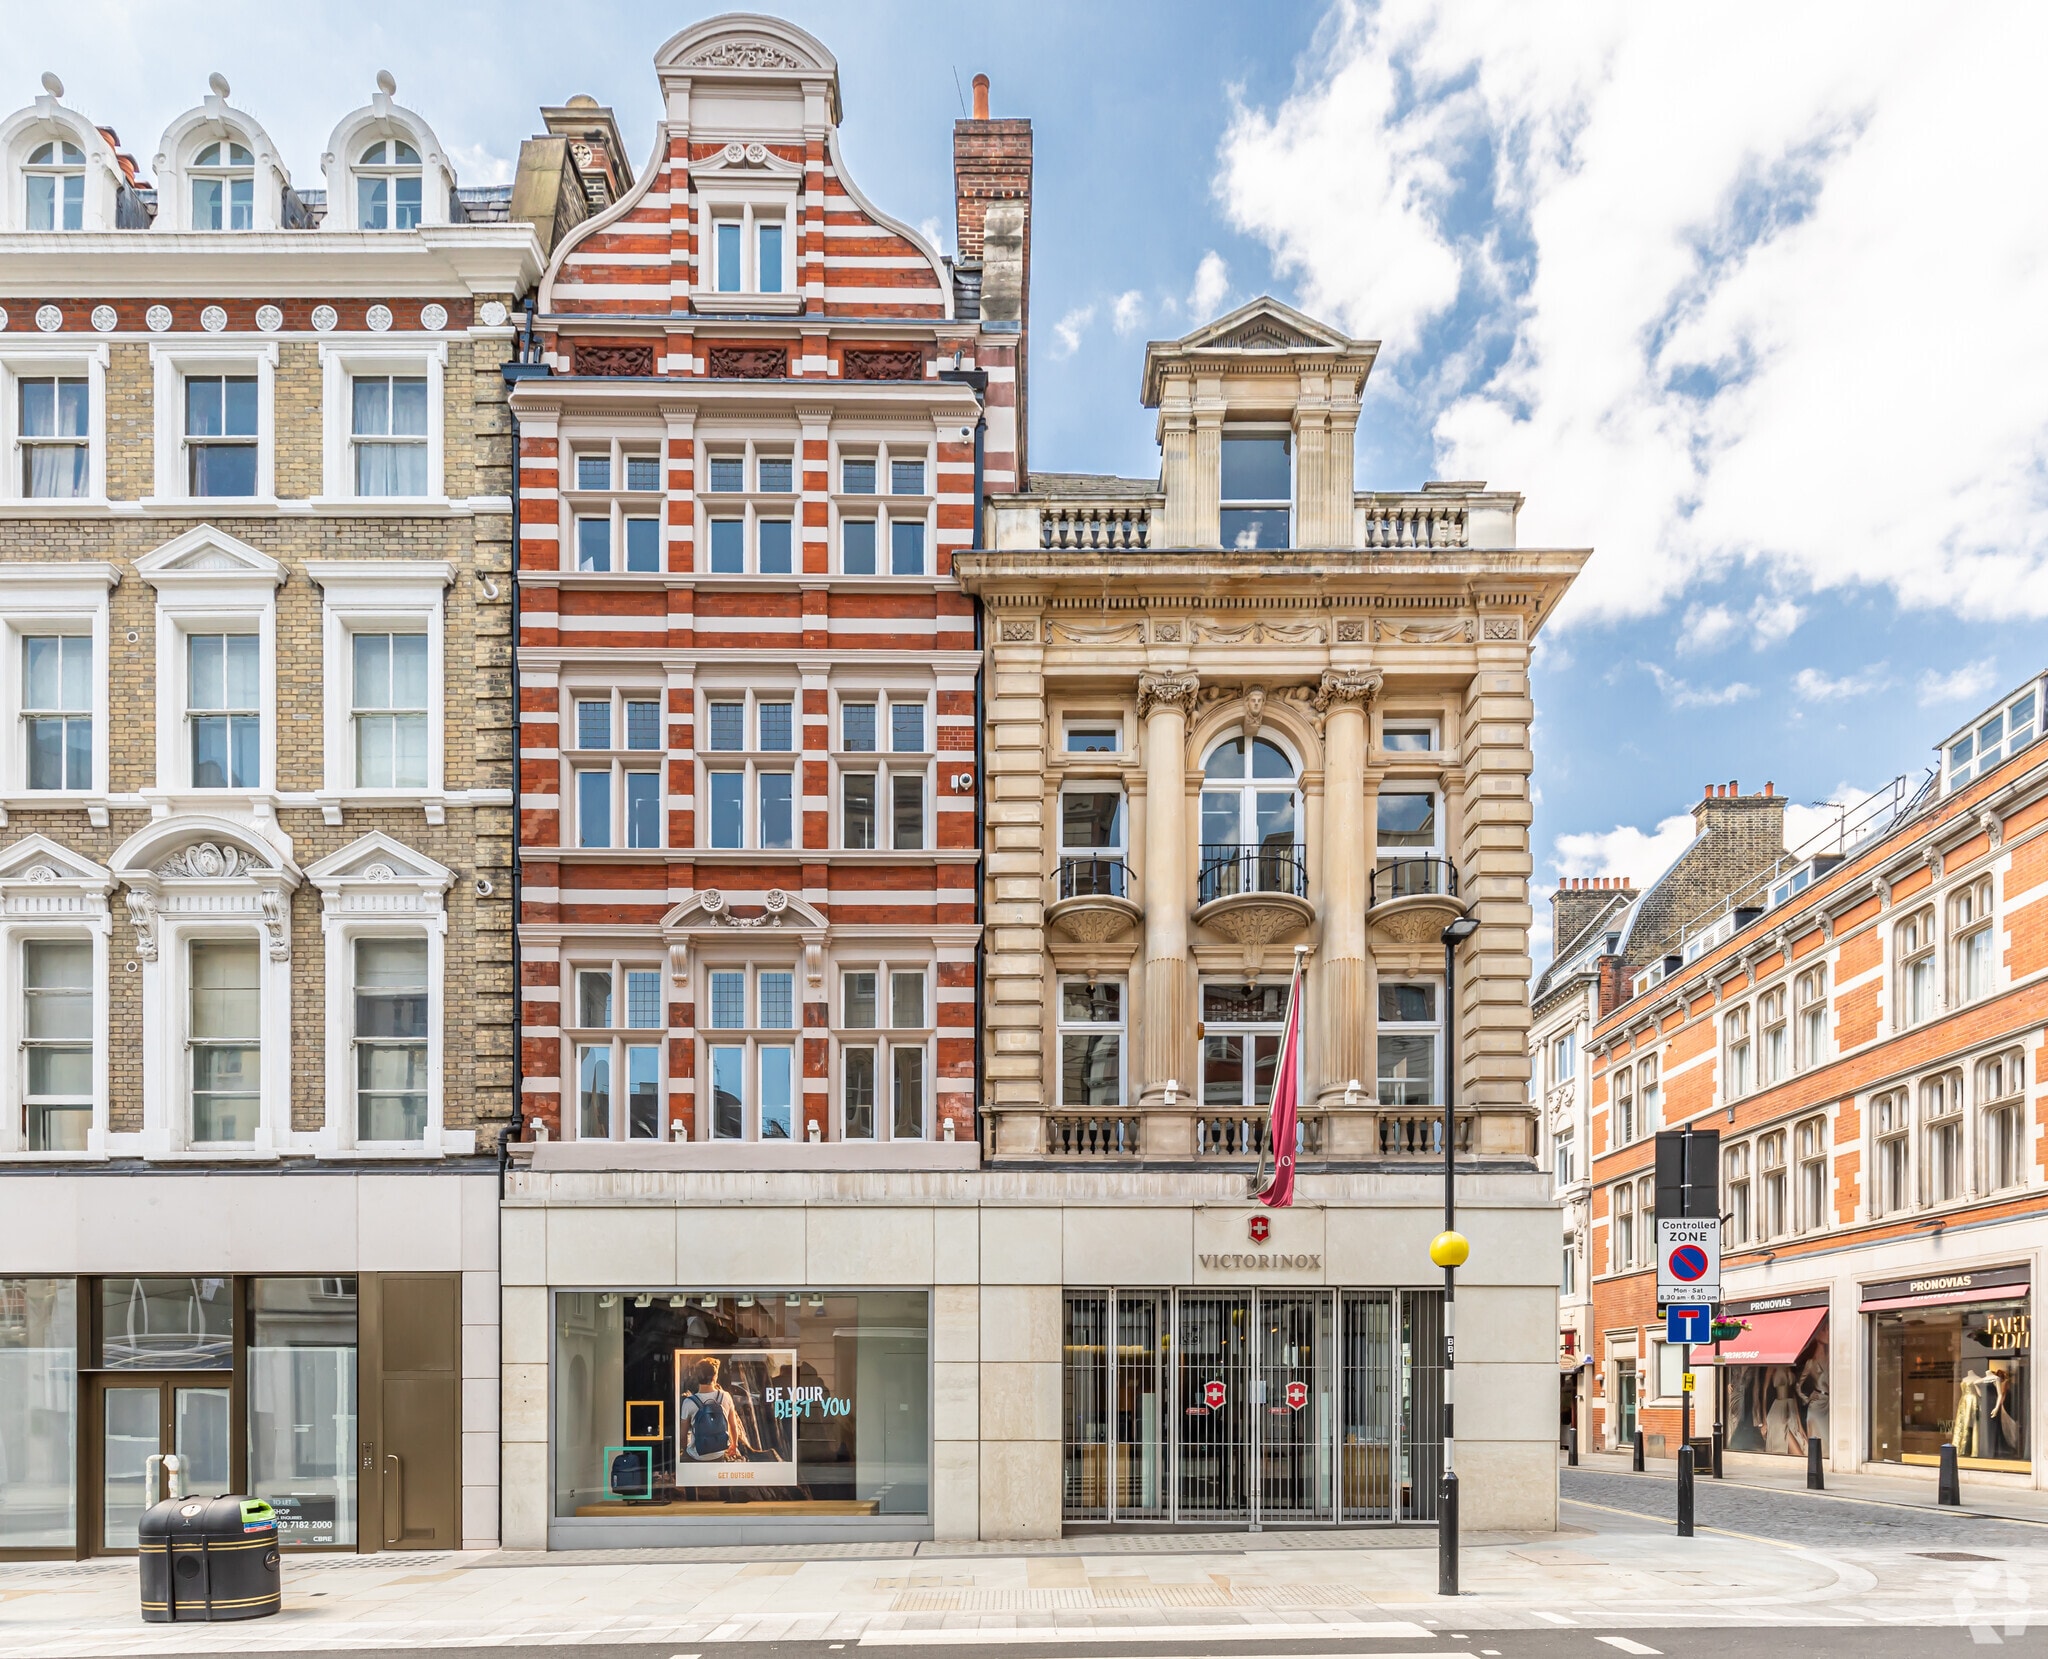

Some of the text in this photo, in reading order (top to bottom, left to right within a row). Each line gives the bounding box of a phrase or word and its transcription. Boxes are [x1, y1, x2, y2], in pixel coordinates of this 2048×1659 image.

[1662, 1221, 1716, 1230] Controlled
[1669, 1231, 1707, 1242] ZONE
[1198, 1254, 1321, 1269] VICTORINOX
[1910, 1275, 1972, 1292] PRONOVIAS
[1750, 1298, 1792, 1311] PRONOVIAS
[1986, 1314, 2032, 1335] PART
[765, 1386, 823, 1403] BE YOUR
[774, 1397, 851, 1420] BEST YOU
[717, 1471, 755, 1479] GET OUTSIDE
[290, 1520, 309, 1529] 7182
[312, 1520, 333, 1529] 2000
